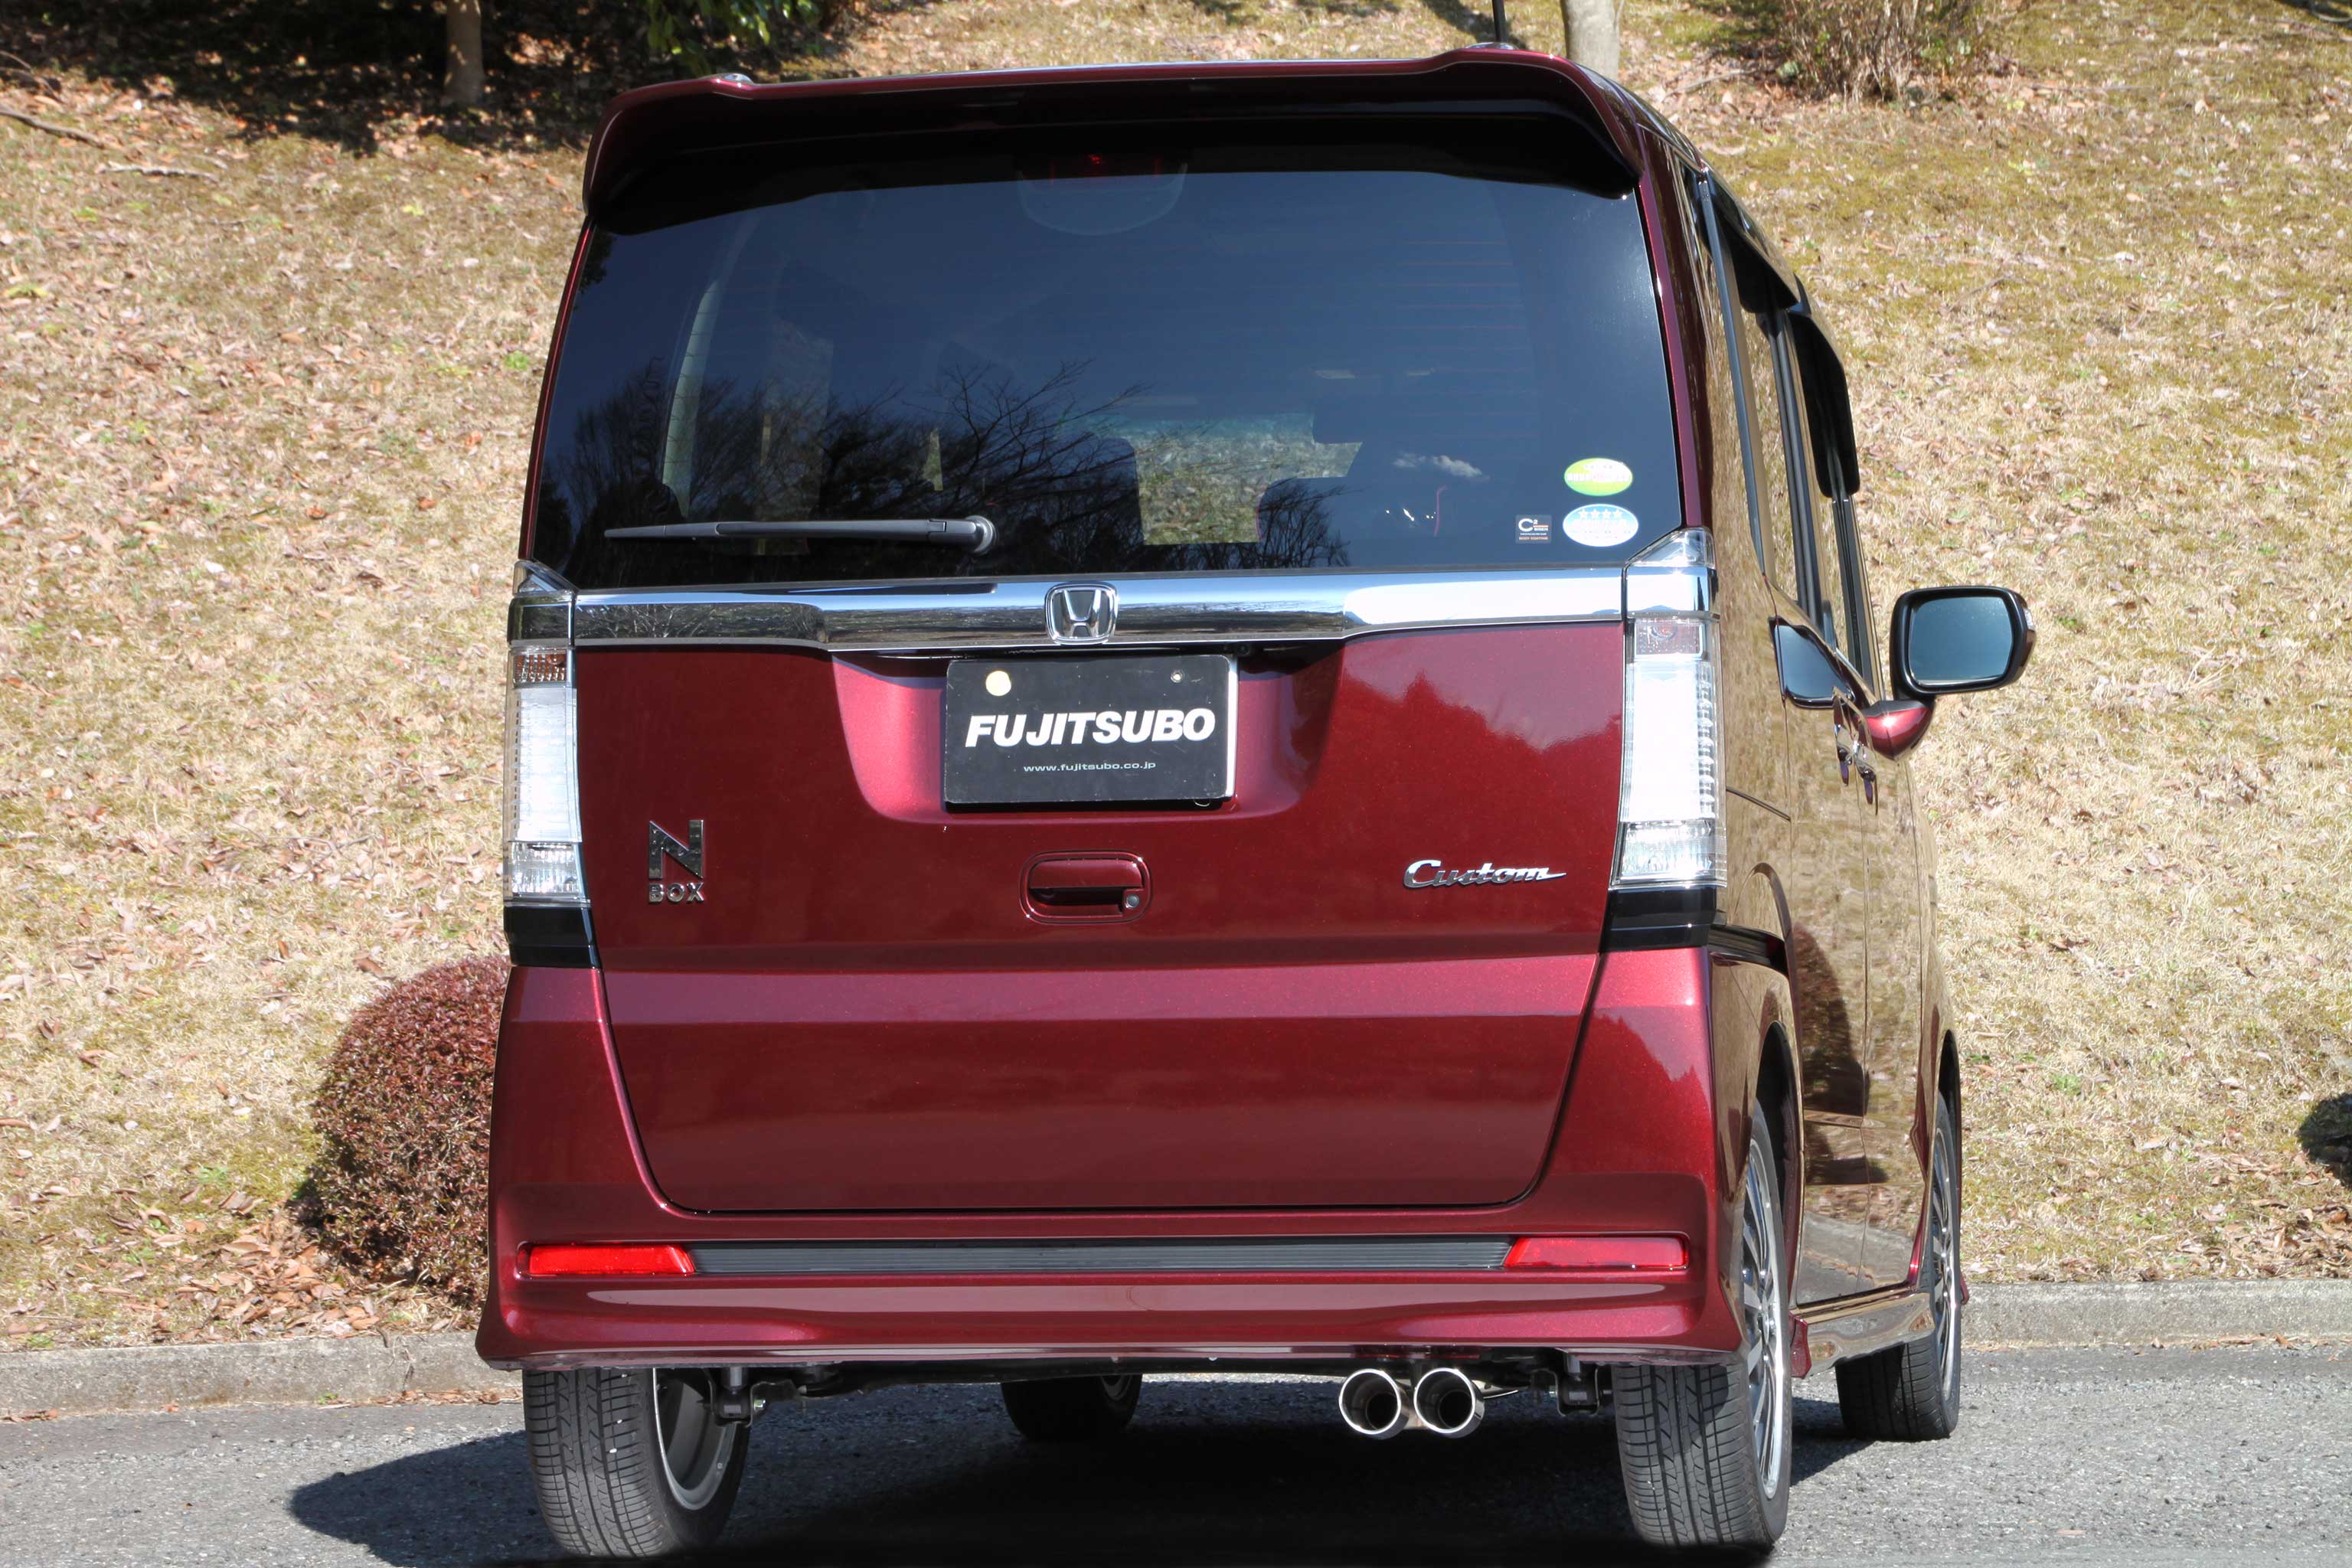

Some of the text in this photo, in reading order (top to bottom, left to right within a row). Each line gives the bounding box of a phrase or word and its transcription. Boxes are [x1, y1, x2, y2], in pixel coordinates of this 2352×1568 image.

[965, 707, 1216, 748] FUJITSUBO
[1023, 761, 1156, 772] www.fujitsubo.co.jp
[648, 819, 704, 880] N
[1403, 859, 1566, 889] Custom
[648, 882, 705, 903] BOX
